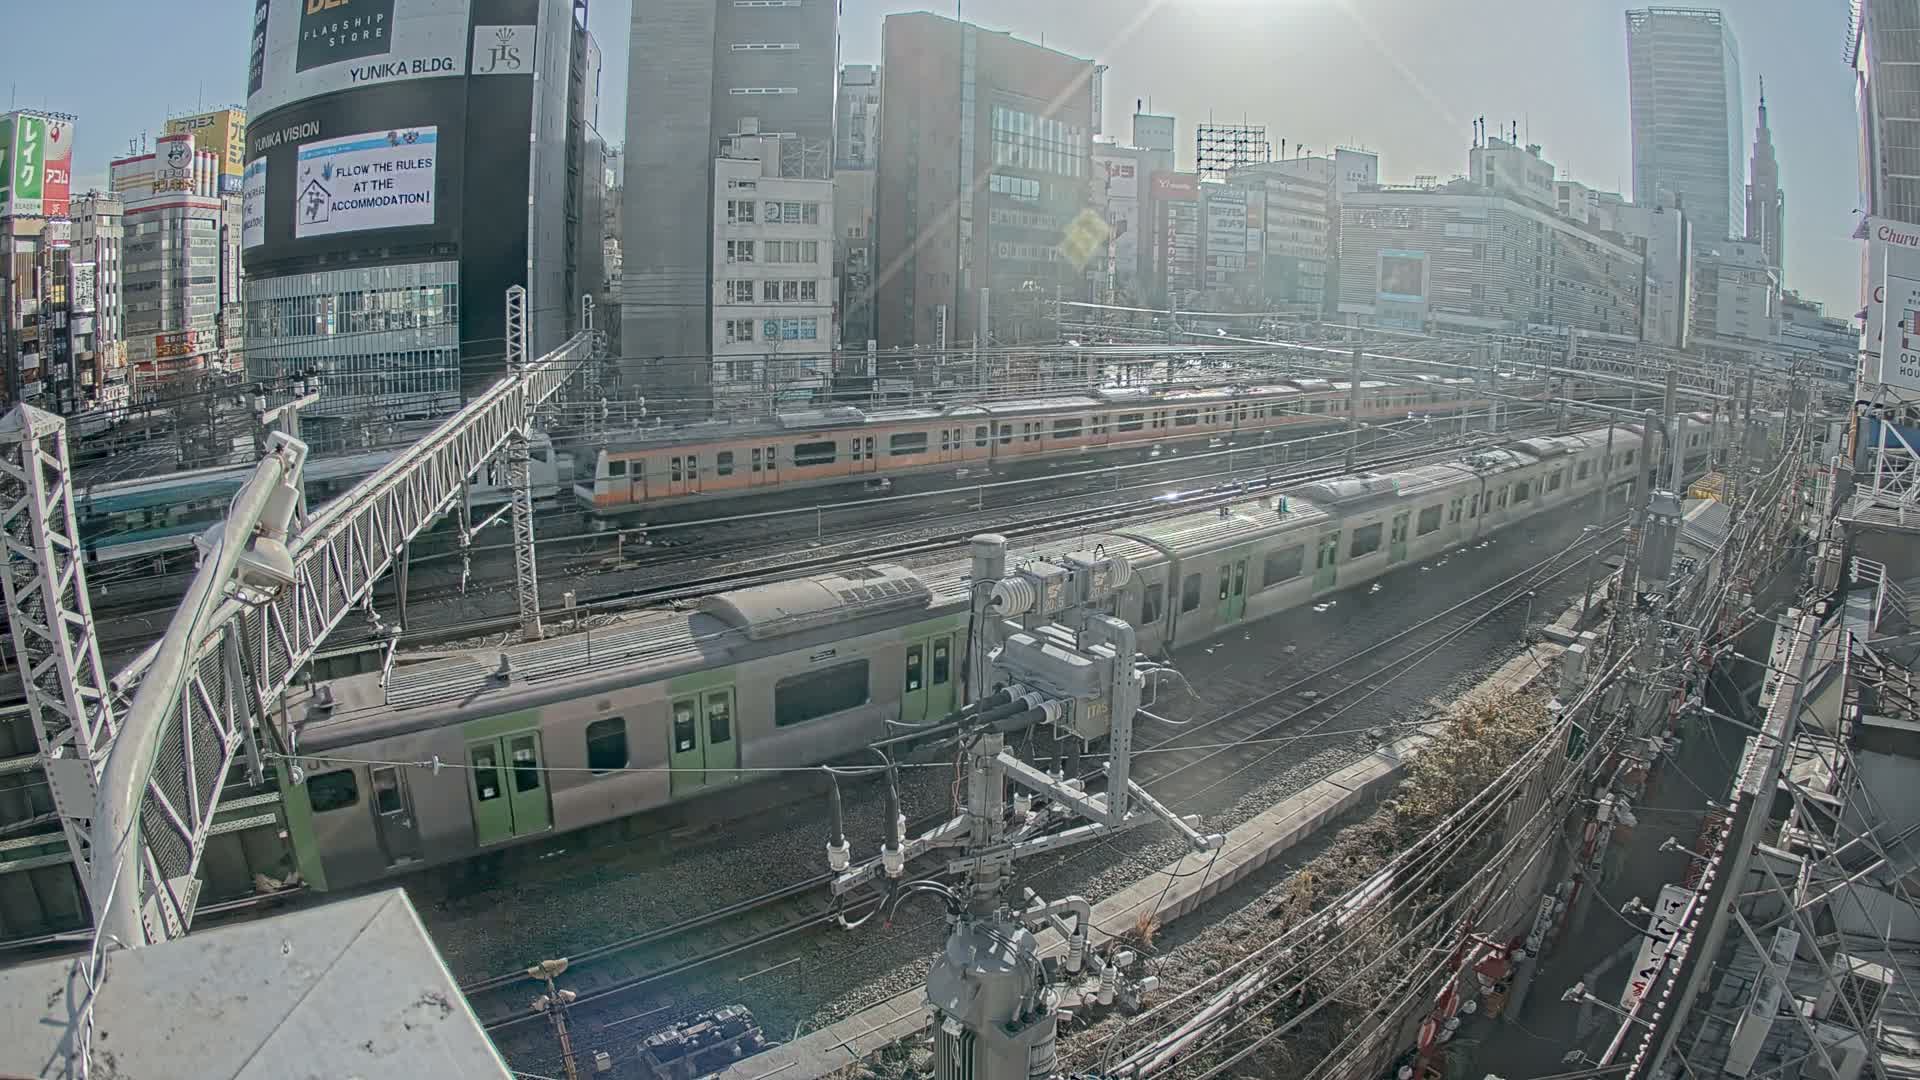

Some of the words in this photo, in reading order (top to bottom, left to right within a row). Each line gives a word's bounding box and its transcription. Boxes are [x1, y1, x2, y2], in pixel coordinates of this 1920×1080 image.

[304, 13, 384, 41] FLAGSHIP
[329, 27, 383, 47] STORE
[350, 60, 408, 83] YUNIKA
[412, 57, 456, 75] BLDG.
[254, 130, 281, 153] YUNIKA
[282, 120, 320, 143] VISION
[22, 119, 39, 188] レイク
[45, 168, 69, 185] アコム
[373, 161, 393, 173] THE
[396, 158, 433, 171] RULES
[353, 181, 368, 193] AT
[370, 178, 394, 190] THE
[331, 190, 430, 212] ACCOMMODATION!
[1878, 225, 1919, 247] Churu
[1900, 353, 1920, 367] OP
